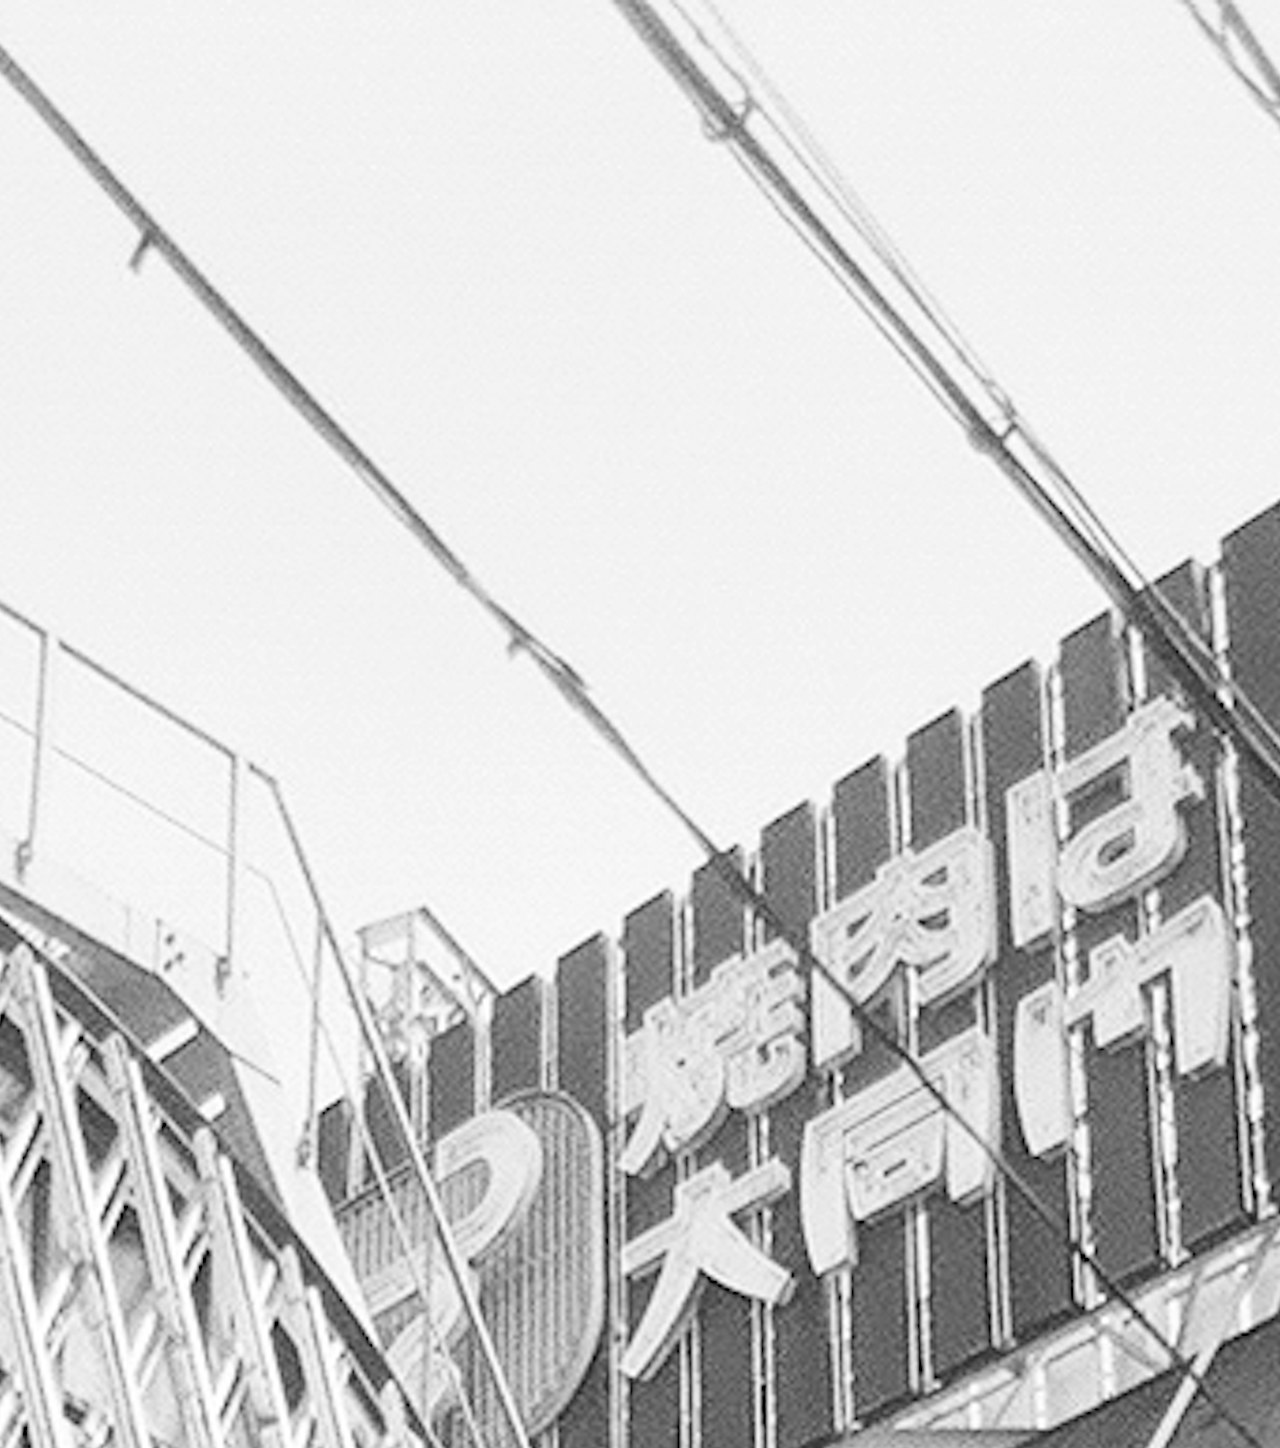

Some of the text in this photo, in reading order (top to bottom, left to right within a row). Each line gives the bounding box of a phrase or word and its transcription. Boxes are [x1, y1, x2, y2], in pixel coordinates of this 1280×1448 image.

[616, 695, 1208, 1178] 焼肉は
[618, 893, 1232, 1380] 大同門
